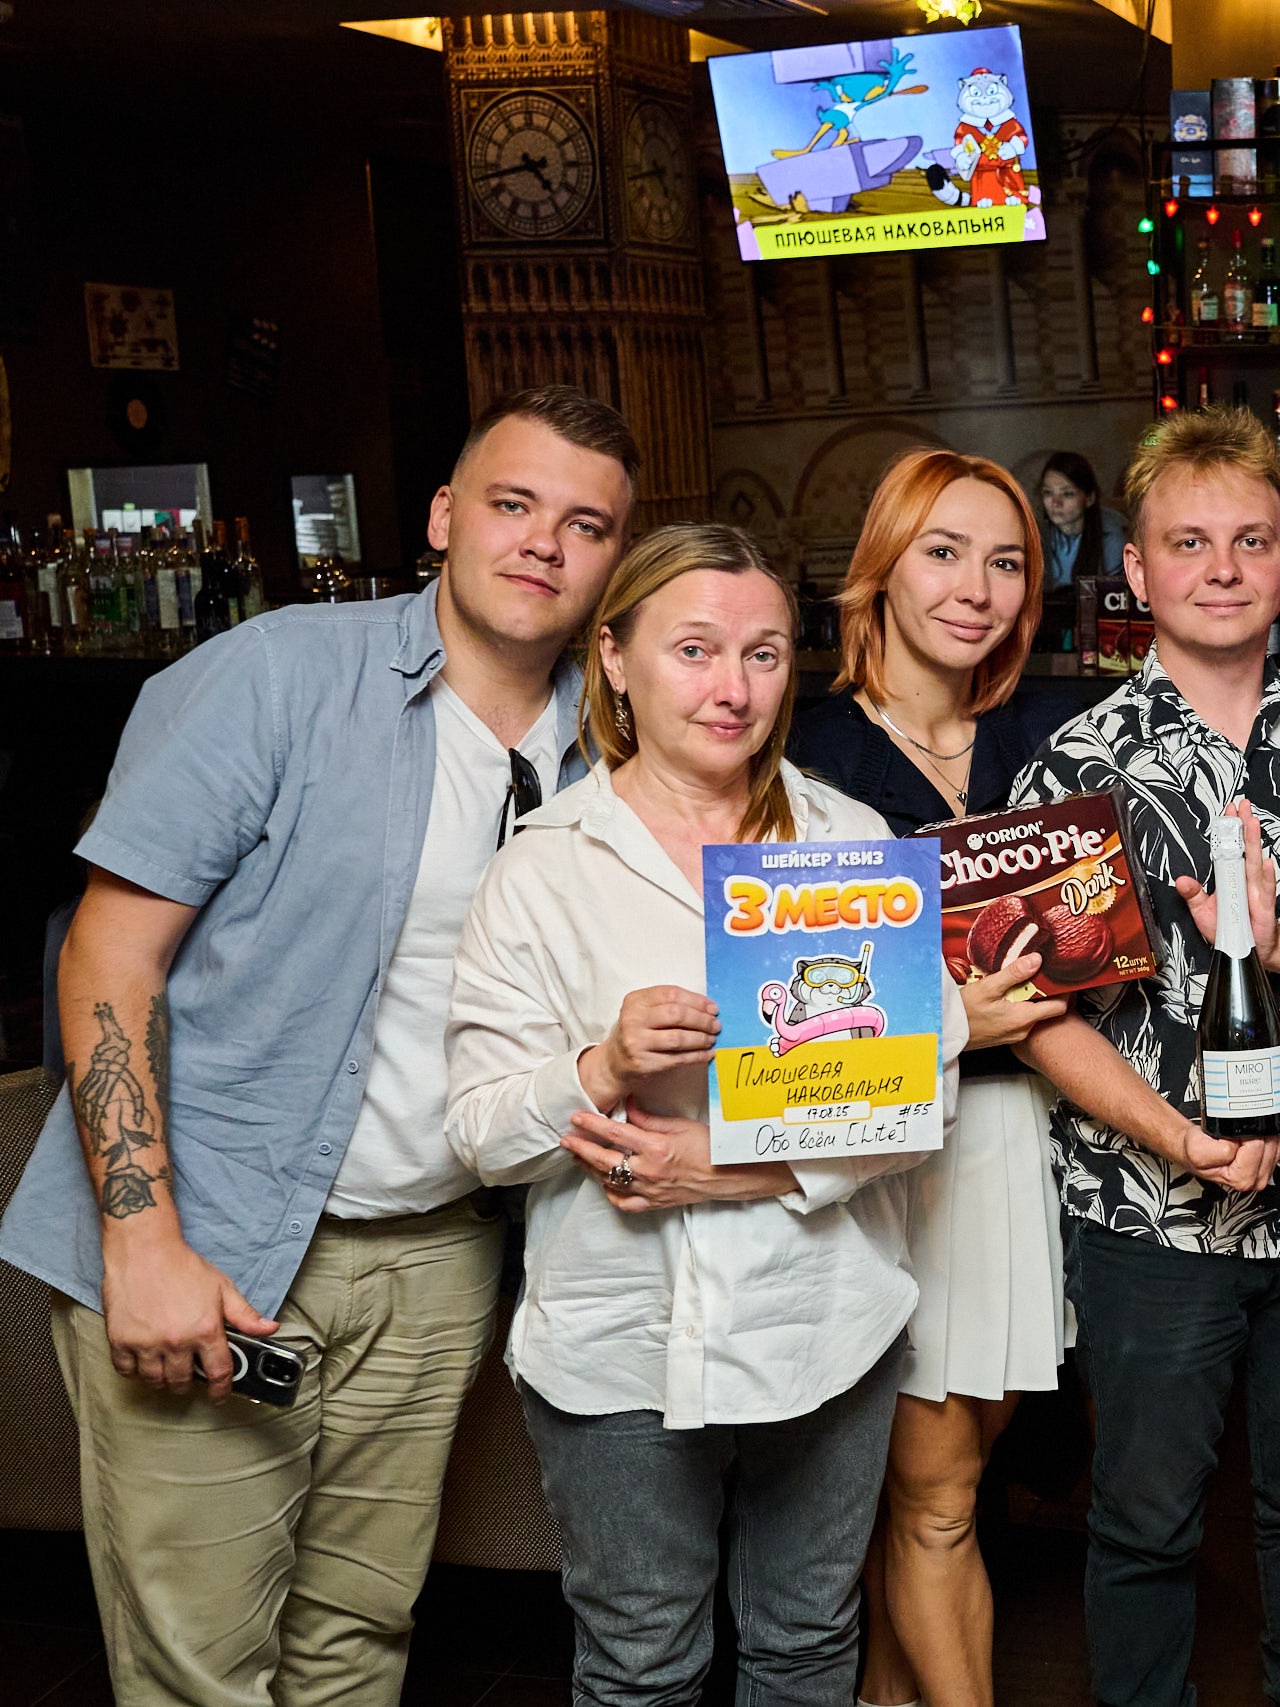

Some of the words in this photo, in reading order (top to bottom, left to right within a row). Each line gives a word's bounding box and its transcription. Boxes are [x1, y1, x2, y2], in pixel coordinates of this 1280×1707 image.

[775, 226, 876, 248] ПЛЮШЕВАЯ
[883, 216, 1006, 240] НАКОВАЛЬНЯ
[986, 822, 1041, 845] ORION
[762, 850, 832, 869] ШЕЙКЕР
[837, 850, 884, 867] КВИЗ
[1060, 862, 1127, 916] Dark
[728, 881, 769, 933] 3
[773, 881, 920, 930] МЕСТО
[1235, 1062, 1264, 1075] MIRO
[756, 1124, 790, 1156] Обо
[799, 1127, 836, 1150] всём
